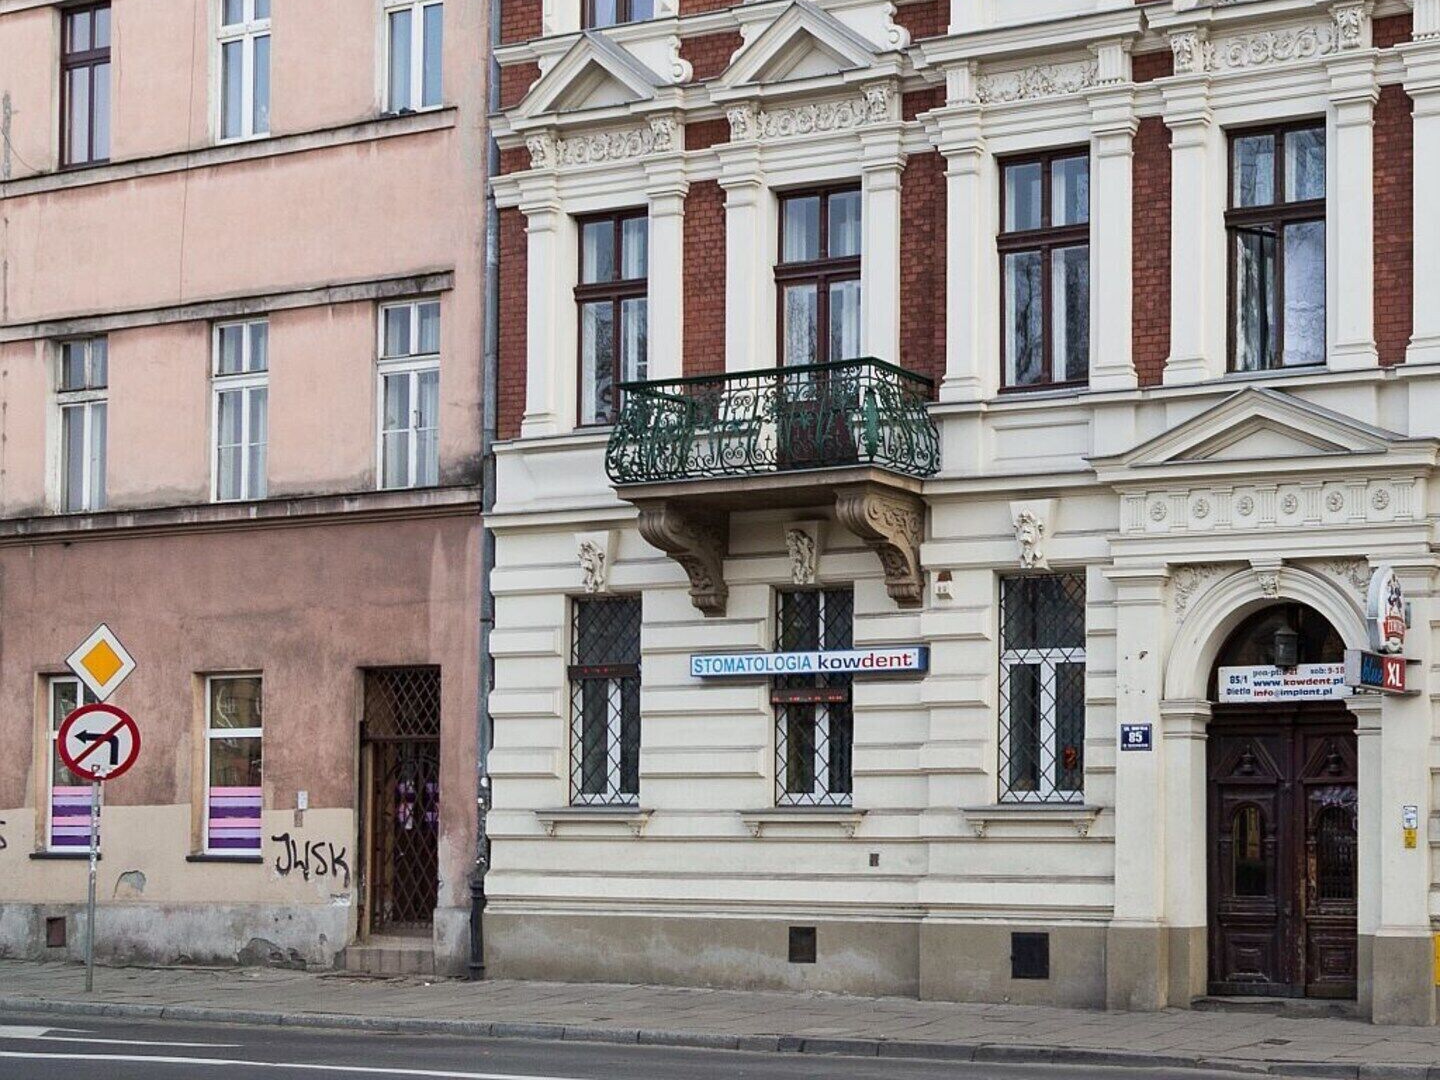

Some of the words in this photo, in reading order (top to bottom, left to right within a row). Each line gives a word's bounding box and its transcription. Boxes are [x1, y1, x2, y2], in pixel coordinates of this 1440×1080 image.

[693, 655, 812, 674] STOMATOLOGIA
[818, 653, 912, 670] kowdent
[1229, 675, 1248, 685] 85/1
[1387, 661, 1403, 687] XL
[1253, 677, 1344, 687] www.kowdent.pl
[1128, 730, 1143, 743] 85
